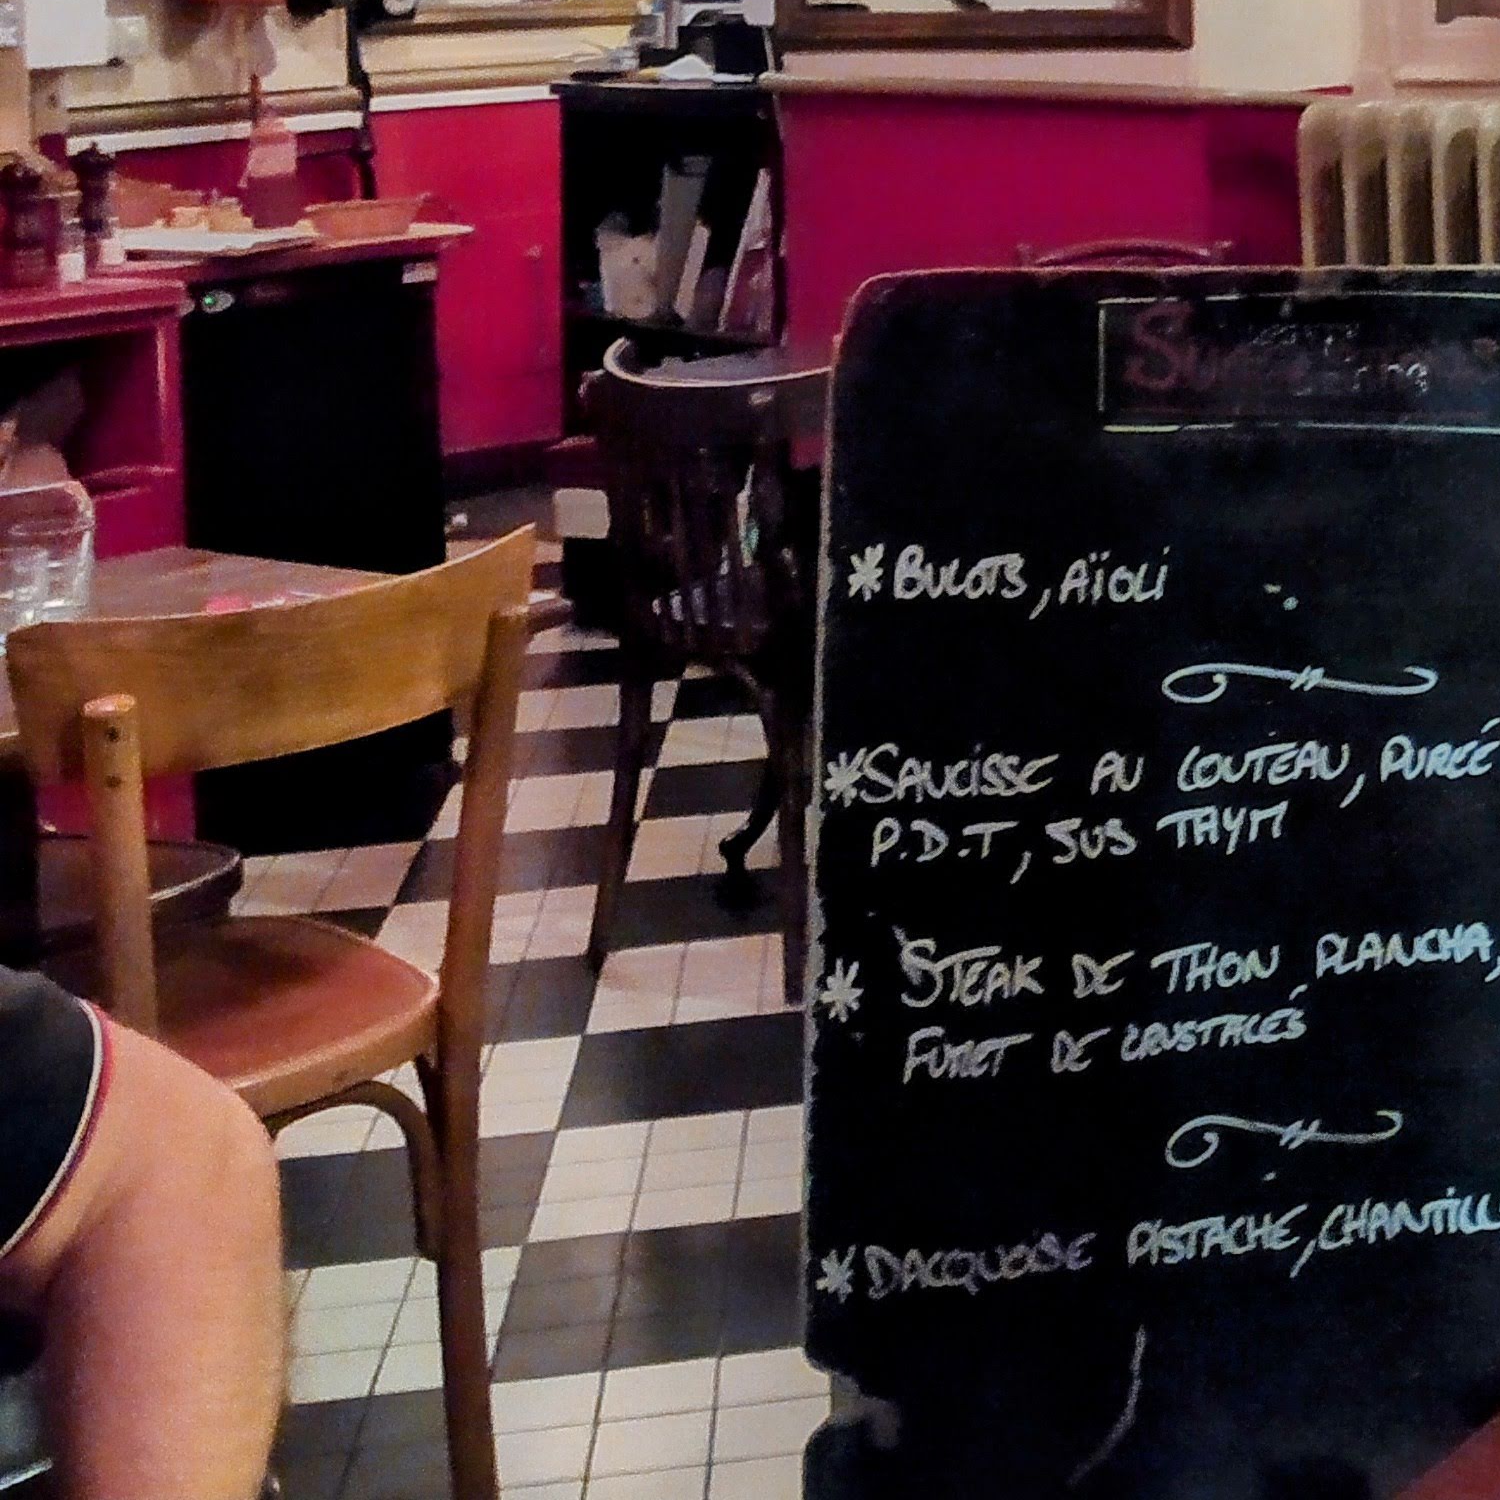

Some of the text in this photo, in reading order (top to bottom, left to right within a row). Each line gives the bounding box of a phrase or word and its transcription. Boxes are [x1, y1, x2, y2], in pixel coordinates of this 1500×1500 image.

[1089, 750, 1145, 796] AU
[900, 936, 1046, 1008] STEAK
[1071, 949, 1136, 999] DE
[1150, 941, 1281, 995] THON
[1050, 1026, 1112, 1074] DE
